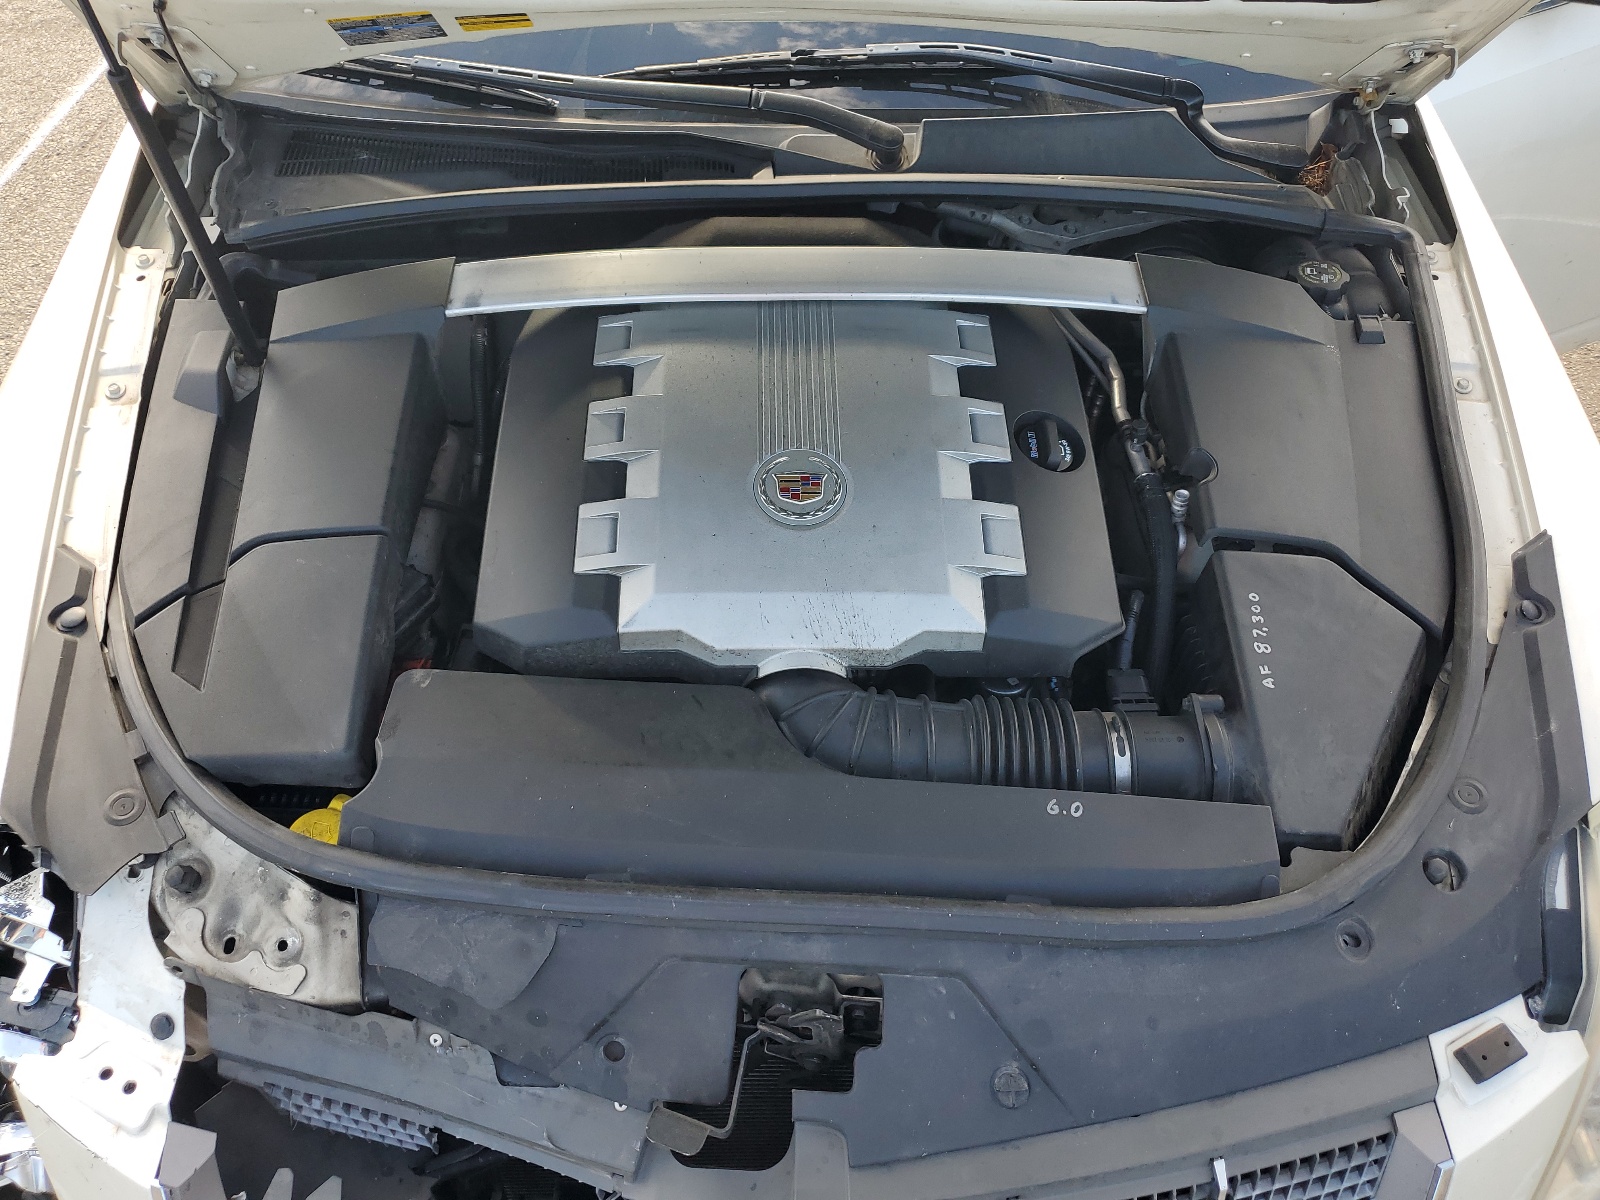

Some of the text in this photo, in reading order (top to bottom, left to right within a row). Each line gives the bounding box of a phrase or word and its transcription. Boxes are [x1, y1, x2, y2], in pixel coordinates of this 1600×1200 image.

[1248, 592, 1276, 690] AF 87,300
[1046, 798, 1084, 818] 6.0
